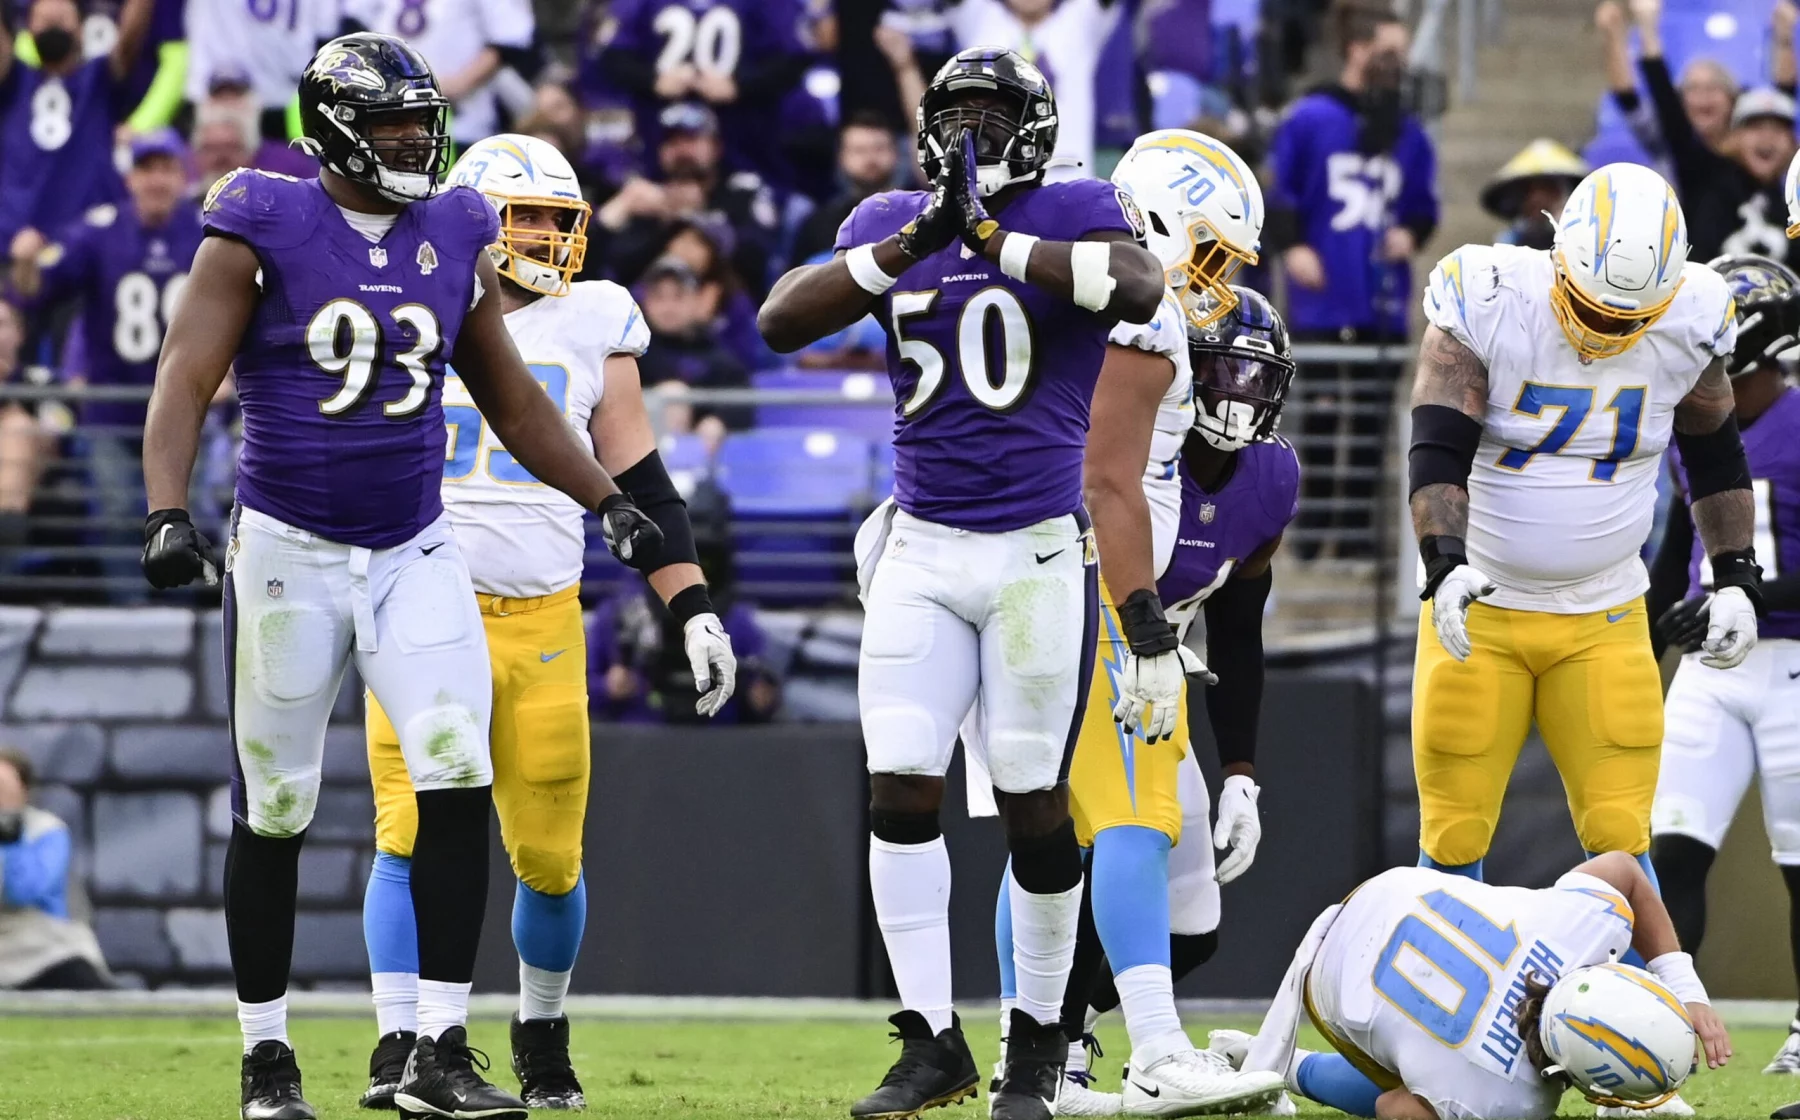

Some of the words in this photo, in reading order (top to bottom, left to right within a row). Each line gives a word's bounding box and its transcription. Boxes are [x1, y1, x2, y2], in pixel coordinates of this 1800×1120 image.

[654, 4, 742, 78] 20
[30, 78, 71, 150] 8
[1168, 164, 1216, 206] 70
[359, 284, 403, 294] RAVENS
[941, 273, 989, 283] RAVENS
[305, 297, 442, 417] 93
[891, 285, 1033, 417] 50
[1492, 380, 1648, 483] 71
[1178, 538, 1215, 549] RAVENS
[1370, 888, 1522, 1050] 10
[1585, 1063, 1625, 1088] 10
